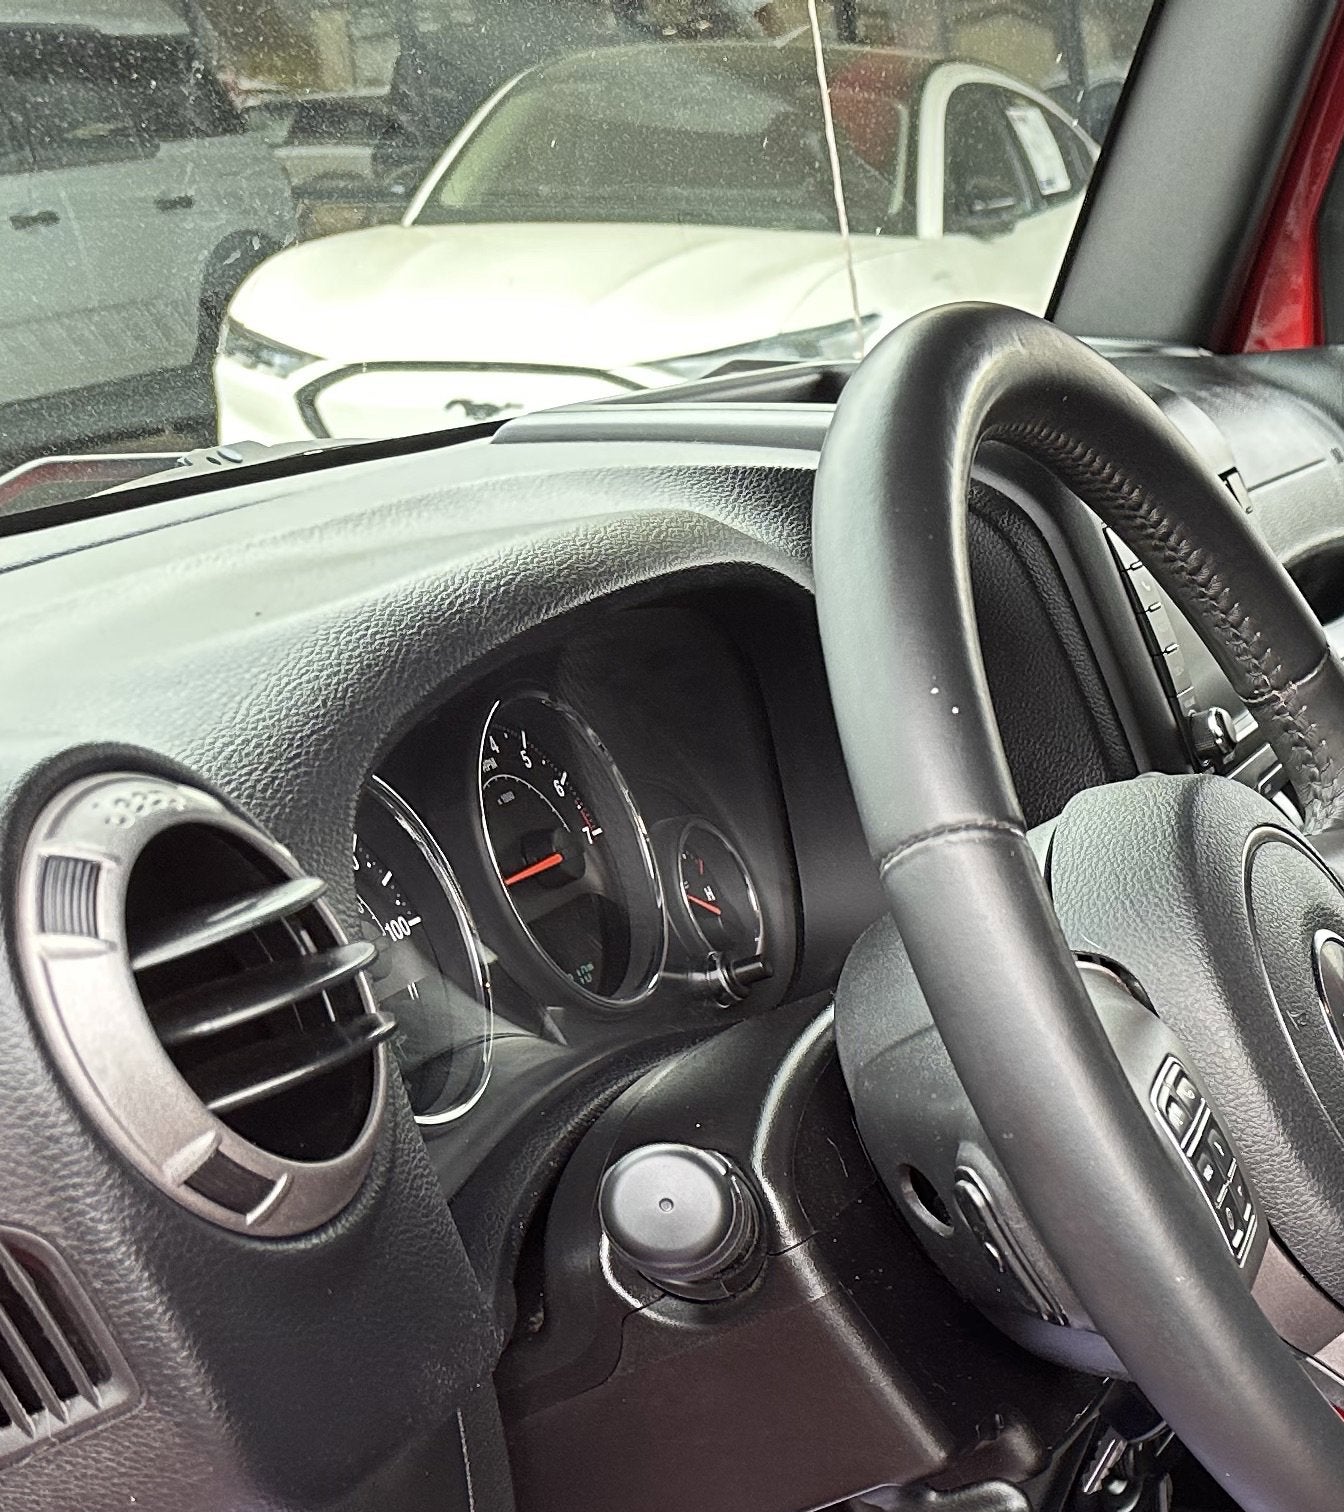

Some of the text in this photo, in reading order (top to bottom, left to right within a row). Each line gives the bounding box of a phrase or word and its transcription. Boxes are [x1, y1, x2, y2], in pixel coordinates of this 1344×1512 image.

[520, 750, 533, 769] 5
[553, 779, 565, 797] 6
[581, 826, 594, 845] 7
[385, 915, 411, 943] 100
